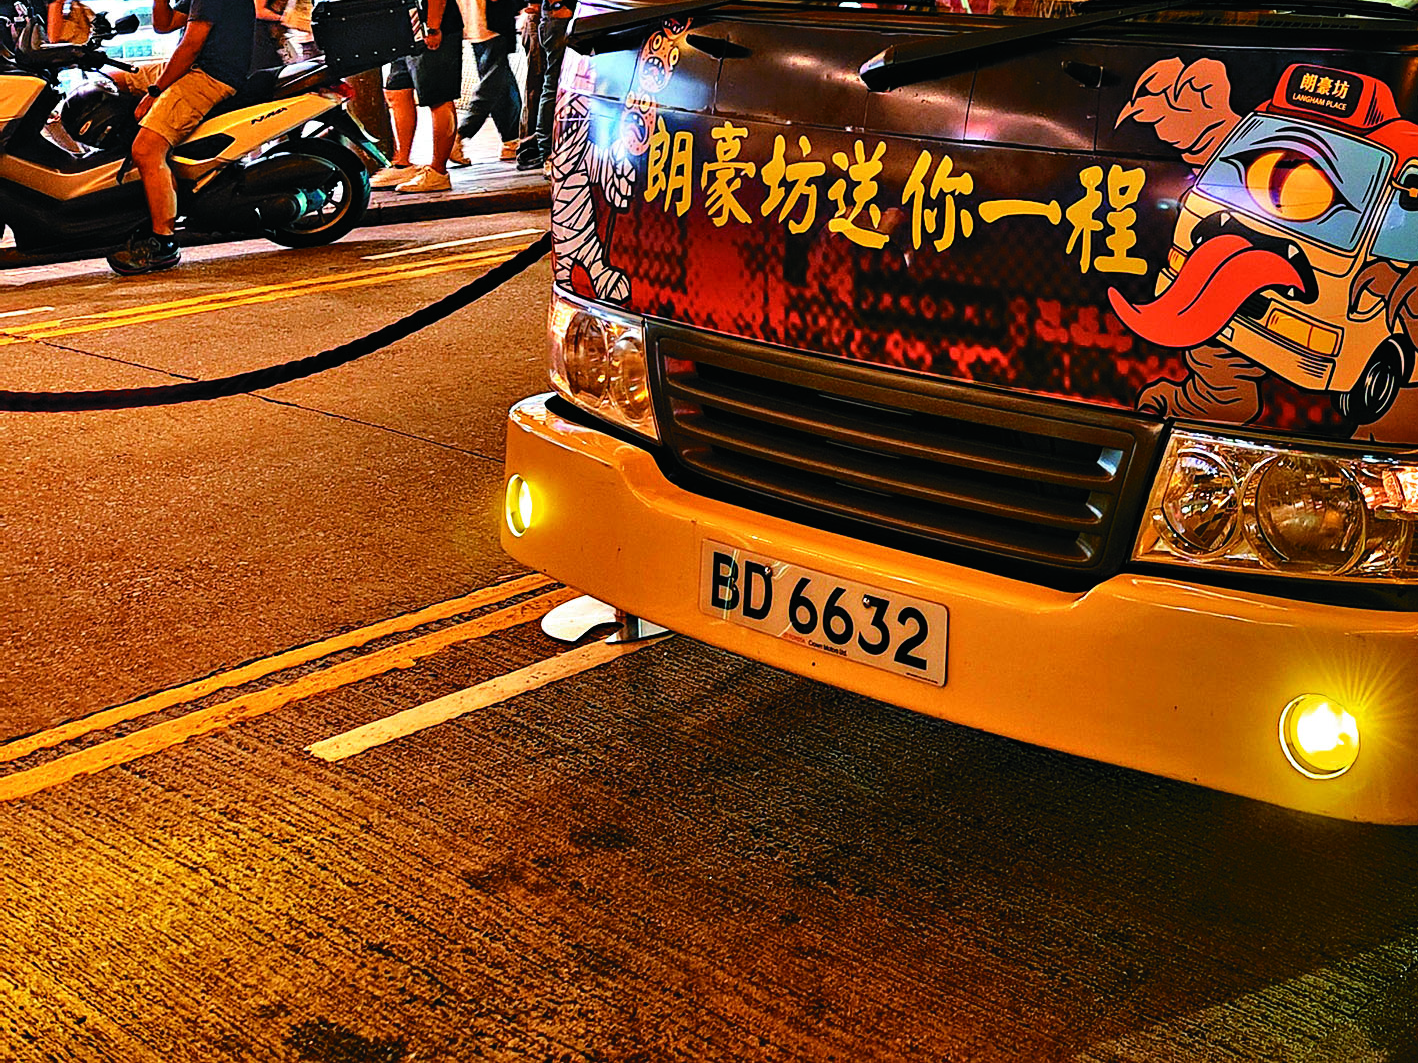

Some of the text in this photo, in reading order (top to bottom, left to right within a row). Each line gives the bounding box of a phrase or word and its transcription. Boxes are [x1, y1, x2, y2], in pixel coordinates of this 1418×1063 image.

[1292, 92, 1348, 111] LANGHAM PLACE
[1299, 72, 1351, 99] 朗豪坊
[644, 117, 1148, 275] 朗豪坊送你一程
[711, 551, 929, 670] BD 6632
